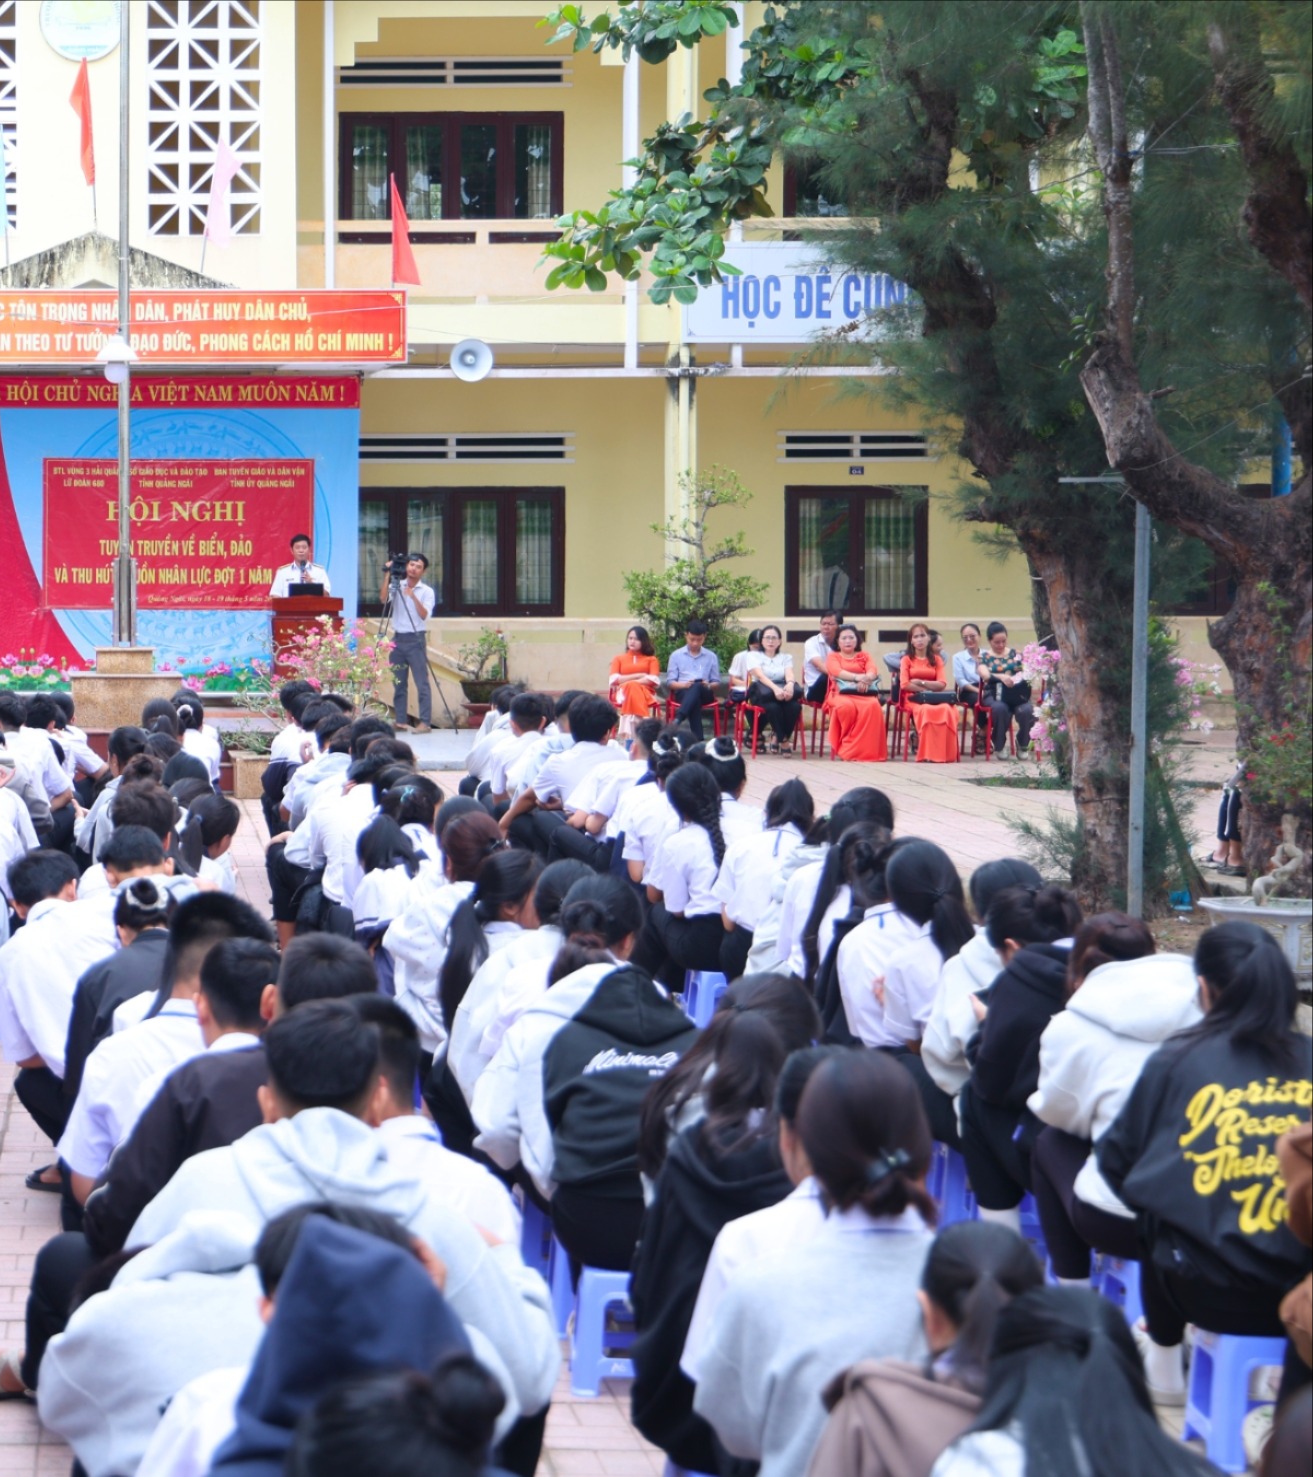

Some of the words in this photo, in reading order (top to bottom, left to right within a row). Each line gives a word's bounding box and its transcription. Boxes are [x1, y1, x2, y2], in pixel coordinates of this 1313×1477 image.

[11, 298, 37, 321] TÔN
[41, 302, 88, 325] TRỌNG
[91, 299, 131, 321] NHÂ
[136, 299, 169, 323] DÂN,
[173, 298, 209, 321] PHÁT
[213, 302, 242, 321] HUY
[245, 298, 274, 321] DÂN
[278, 296, 311, 323] CHỦ,
[722, 274, 781, 328] HỌC
[14, 332, 50, 351] THEO
[199, 332, 248, 352] PHONG
[252, 328, 290, 352] CÁCH
[294, 327, 314, 352] HỒ
[318, 327, 341, 352] CHÍ
[345, 332, 384, 352] MINH
[6, 380, 39, 405] HỘI
[44, 378, 81, 401] CHỦ
[87, 384, 143, 401] NGHA
[148, 380, 189, 406] VIỆT
[194, 384, 233, 402] NAM
[237, 380, 290, 402] MUÔN
[295, 380, 335, 402] NĂM
[170, 500, 246, 526] NGHỊ
[99, 539, 134, 556] TUYN
[137, 534, 178, 556] TRUYỀN
[181, 534, 195, 556] VỀ
[199, 532, 227, 559] BIỂN,
[230, 535, 253, 556] ĐẢO
[54, 563, 68, 584] VÀ
[71, 567, 92, 584] THU
[159, 564, 187, 585] NHÂN
[191, 566, 211, 587] LỰC
[214, 566, 235, 587] ĐỢT
[240, 567, 245, 585] 1
[249, 565, 273, 585] NĂM
